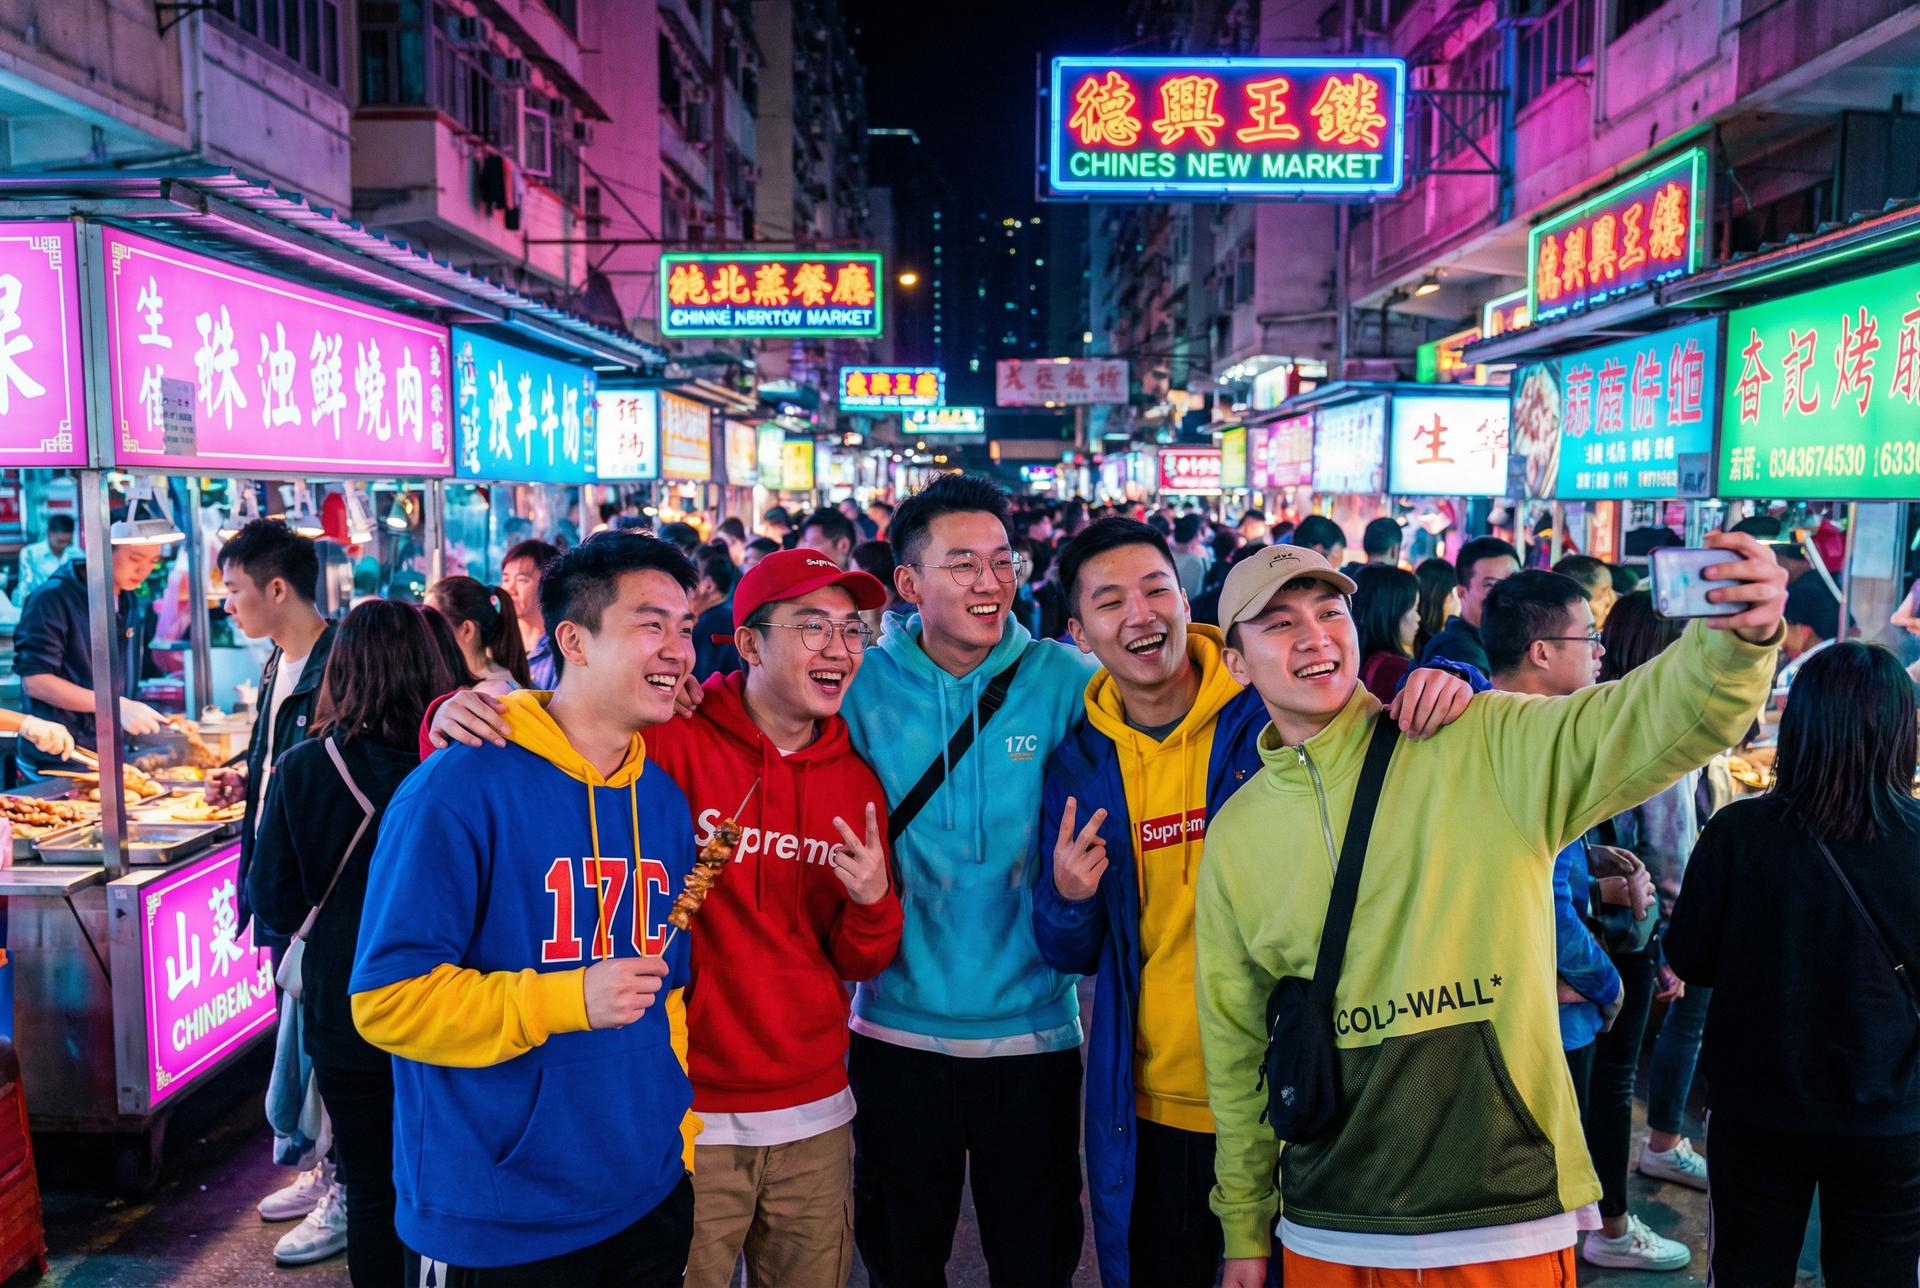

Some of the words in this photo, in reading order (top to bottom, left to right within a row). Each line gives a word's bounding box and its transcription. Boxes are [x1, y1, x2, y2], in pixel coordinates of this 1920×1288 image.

[1070, 152, 1177, 178] CHINES
[1187, 153, 1252, 178] NEW
[1262, 153, 1383, 179] MARKET
[806, 309, 873, 327] MARKET
[1768, 443, 1867, 478] 8343674530
[1005, 735, 1038, 753] 17C
[694, 808, 843, 868] Spreme
[1142, 817, 1205, 844] Suprem
[541, 856, 670, 964] 17C
